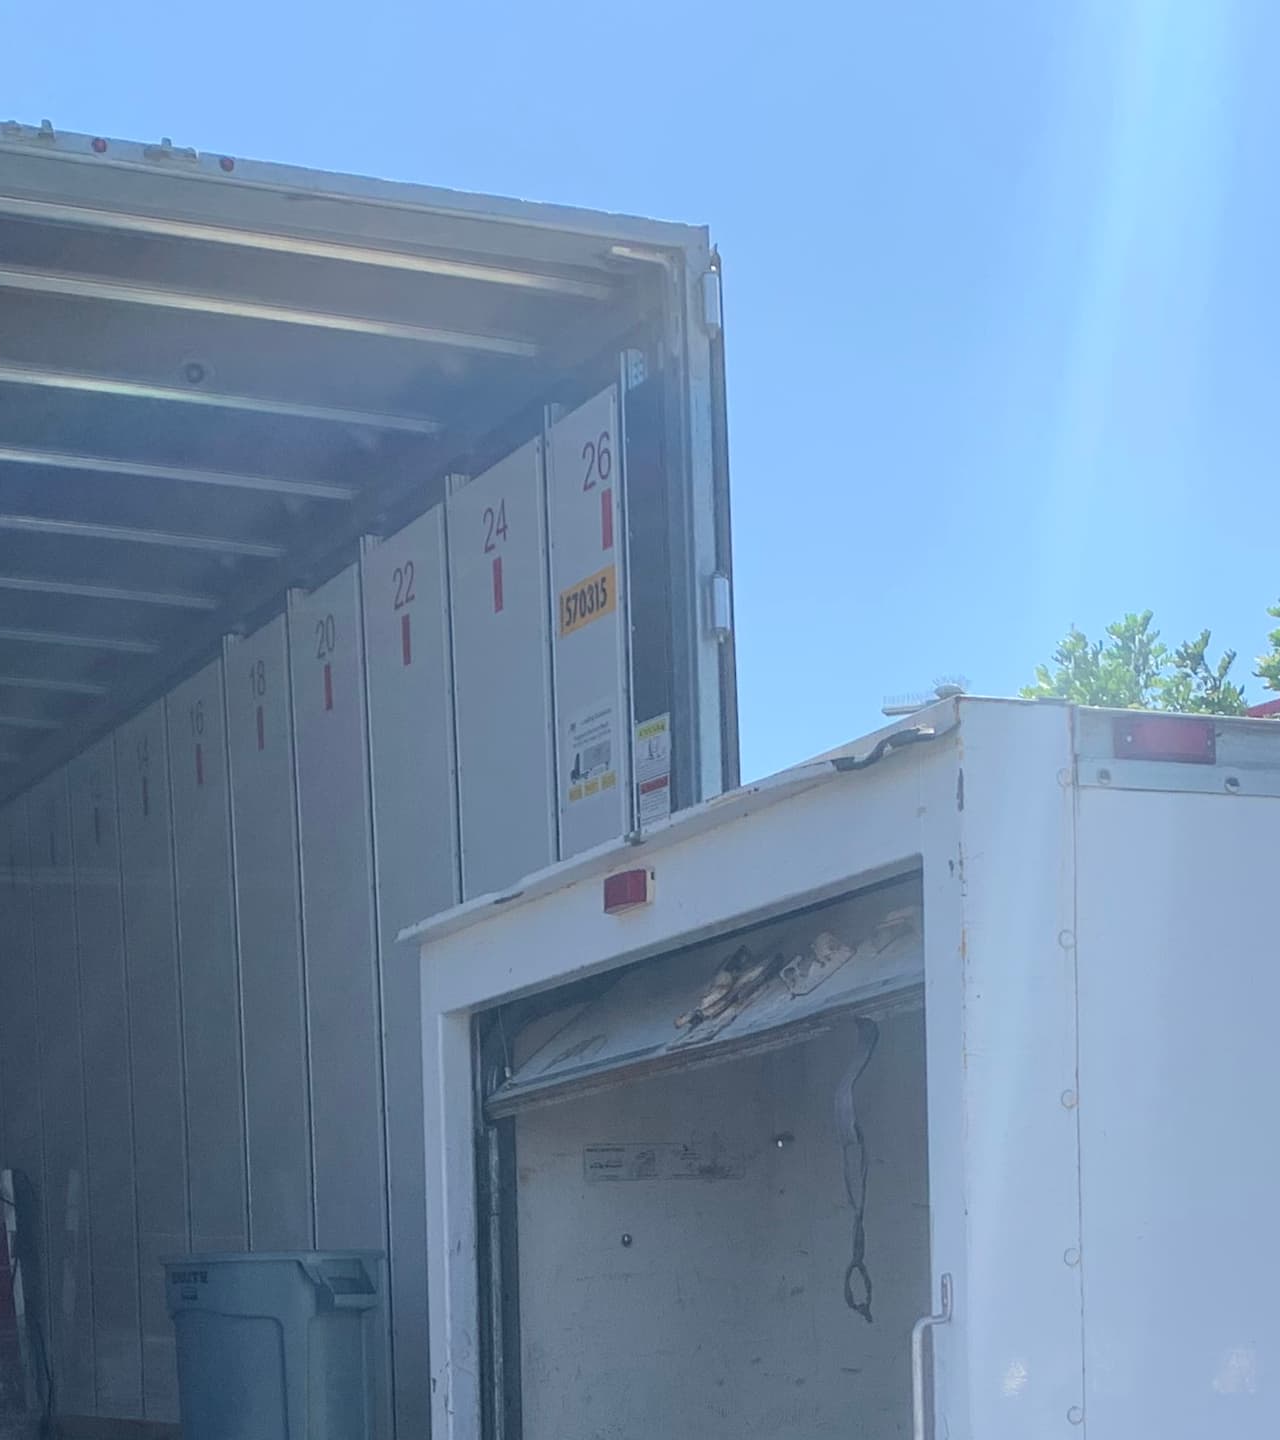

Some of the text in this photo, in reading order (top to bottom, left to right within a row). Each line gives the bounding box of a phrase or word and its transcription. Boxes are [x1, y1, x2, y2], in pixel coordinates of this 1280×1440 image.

[582, 431, 611, 492] 26
[482, 498, 508, 553] 24
[392, 560, 416, 611] 22
[315, 614, 336, 659] 20
[249, 660, 266, 700] 18
